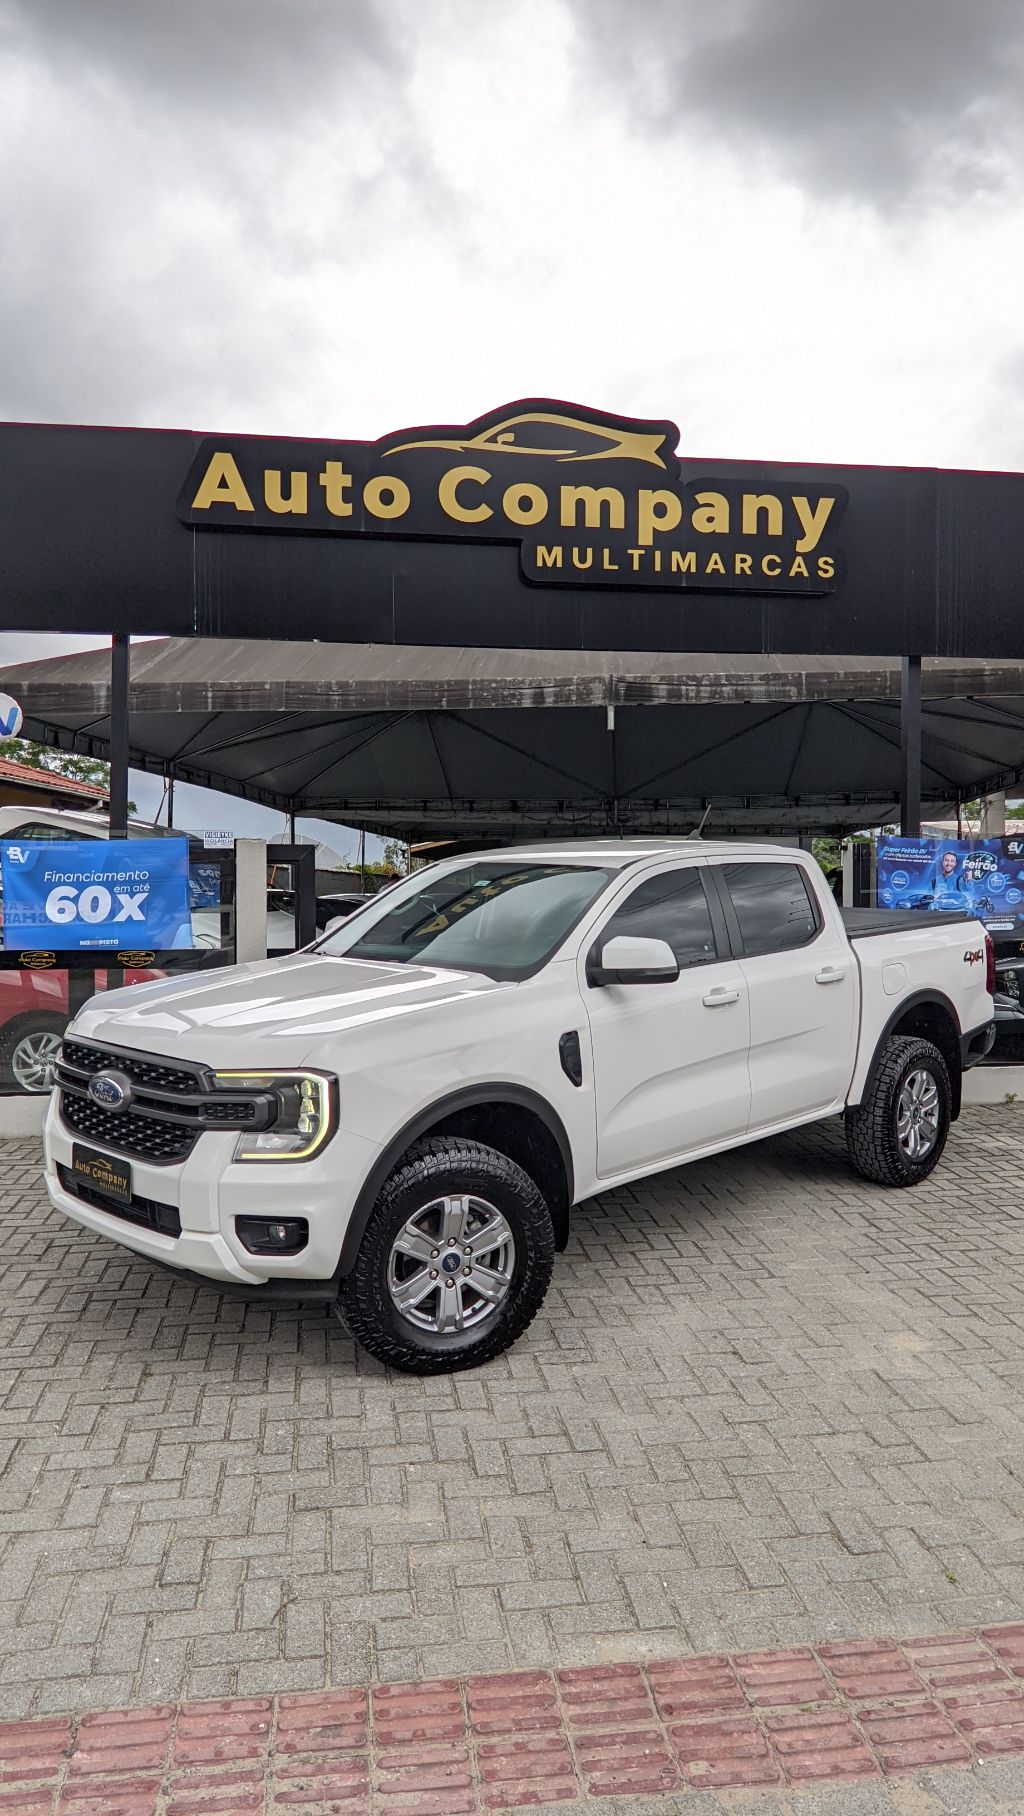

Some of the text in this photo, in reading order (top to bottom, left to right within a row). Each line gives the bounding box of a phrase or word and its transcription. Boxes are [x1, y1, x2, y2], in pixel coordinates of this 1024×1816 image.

[192, 452, 834, 553] Auto Company
[536, 545, 836, 579] MULTIMARCAS
[44, 870, 149, 882] Financiamento
[962, 858, 998, 872] Feirão
[114, 882, 150, 893] em até
[45, 885, 150, 924] 60x
[75, 1159, 128, 1189] Auto Company
